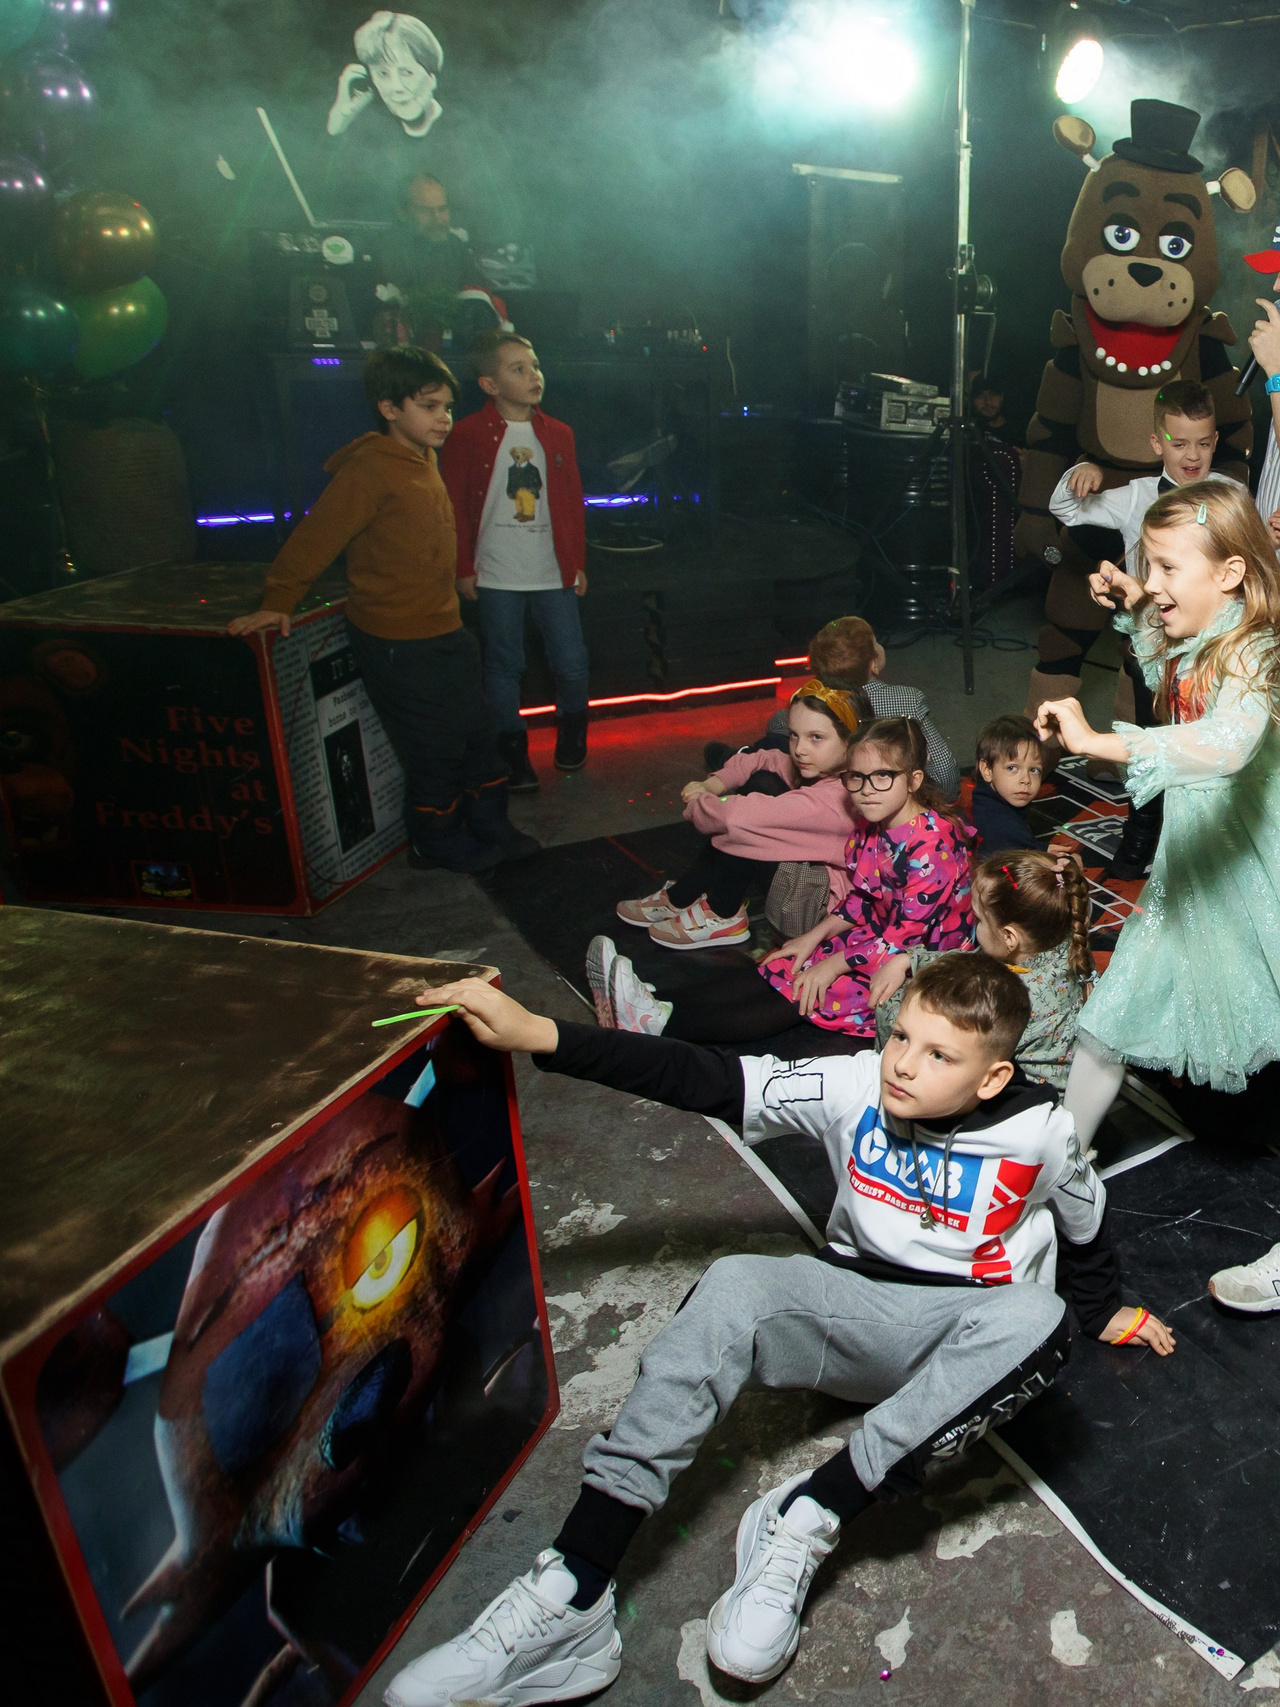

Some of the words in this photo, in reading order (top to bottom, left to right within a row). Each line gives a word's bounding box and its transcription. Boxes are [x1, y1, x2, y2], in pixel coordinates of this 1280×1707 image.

[164, 706, 255, 735] Five
[117, 736, 261, 774] Nights
[229, 779, 267, 802] at
[94, 801, 273, 840] Freddy's
[885, 1193, 907, 1209] BASE
